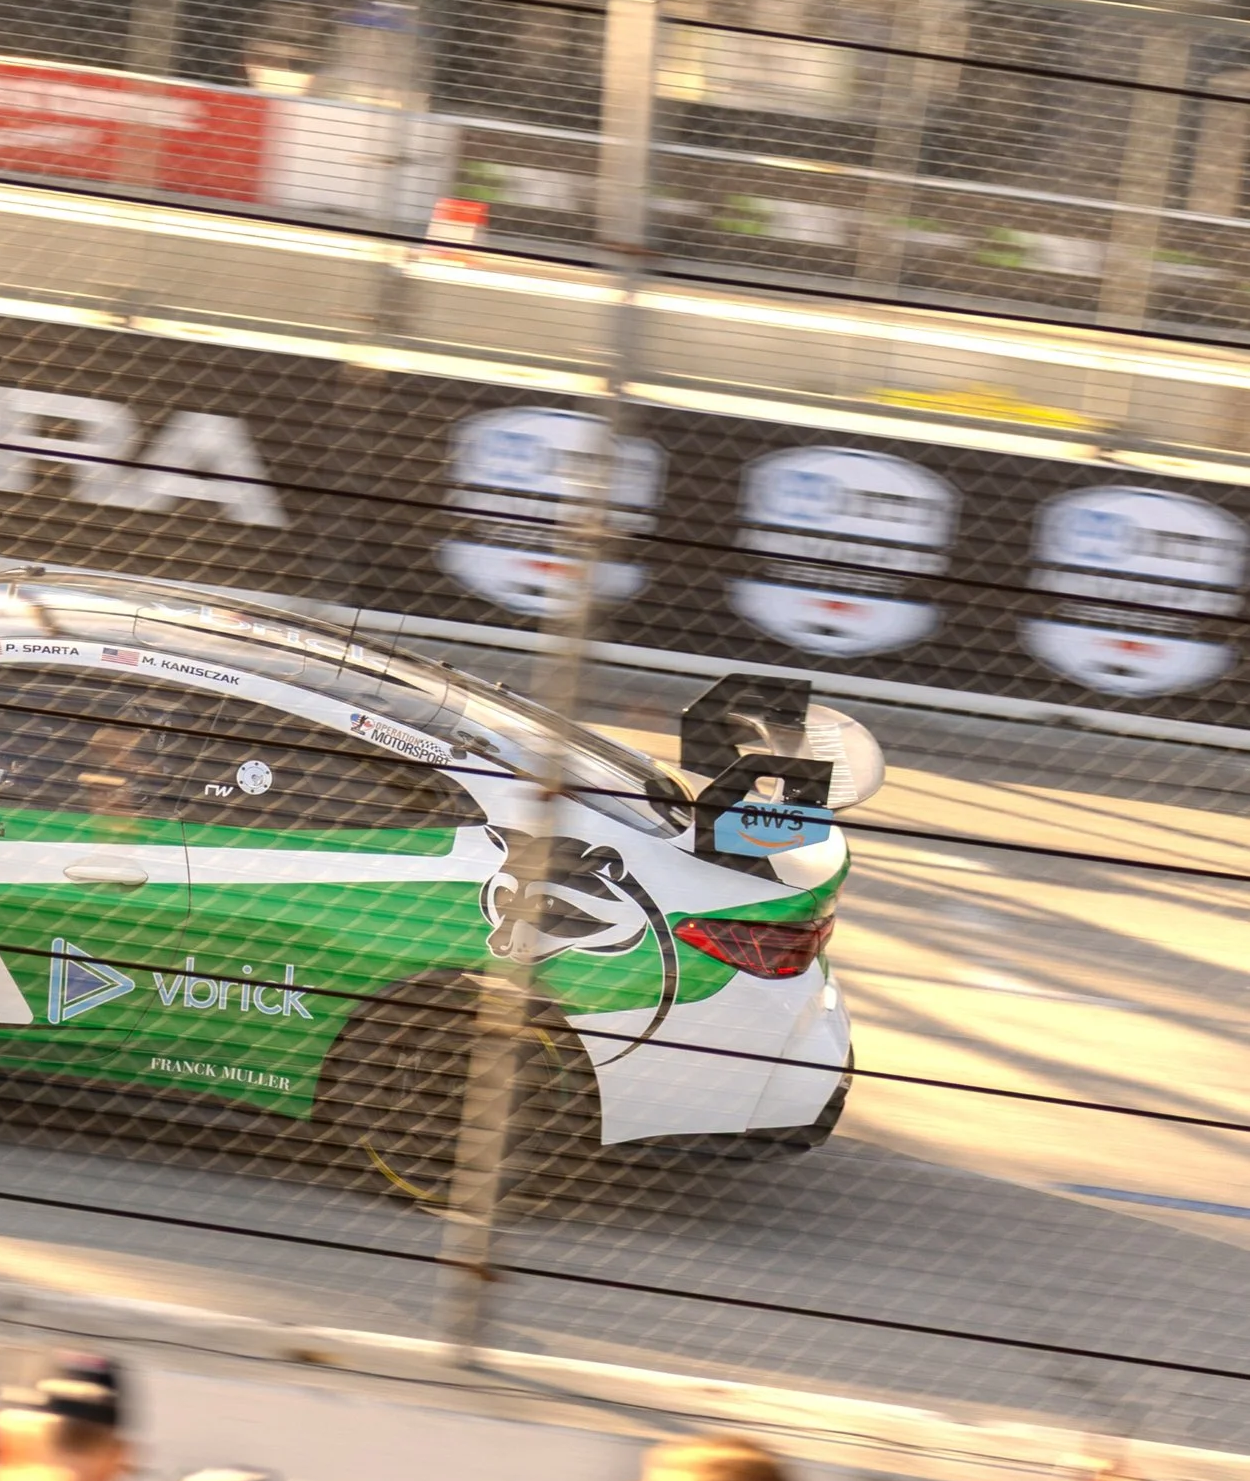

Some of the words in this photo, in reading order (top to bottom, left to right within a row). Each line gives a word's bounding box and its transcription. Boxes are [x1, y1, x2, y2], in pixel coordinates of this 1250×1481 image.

[5, 643, 18, 653] P.
[23, 643, 80, 656] SPARTA
[141, 656, 157, 667] M.
[160, 659, 240, 686] KANISCZAK
[371, 729, 452, 767] MOTORSPORT
[375, 722, 422, 745] OPERATION
[740, 804, 805, 831] aws
[152, 957, 314, 1019] vbrick
[150, 1057, 217, 1078] FRANCK
[221, 1066, 291, 1092] MULLER
